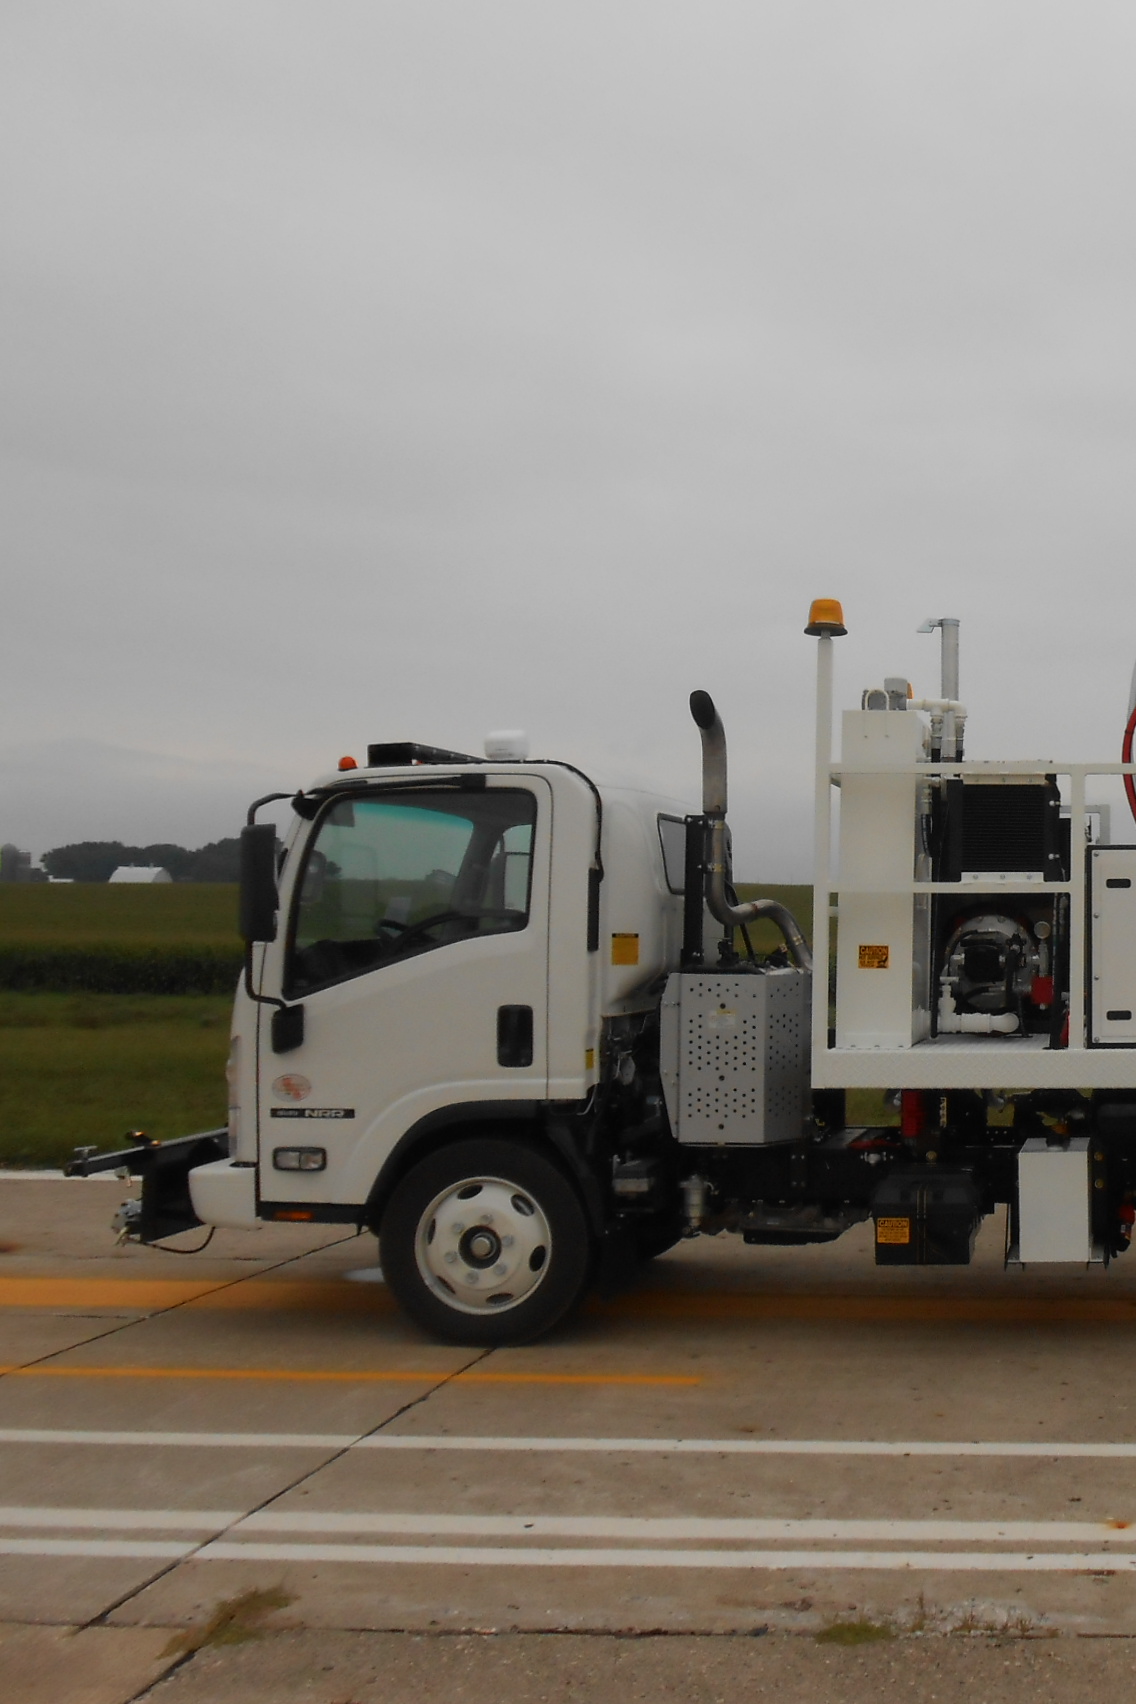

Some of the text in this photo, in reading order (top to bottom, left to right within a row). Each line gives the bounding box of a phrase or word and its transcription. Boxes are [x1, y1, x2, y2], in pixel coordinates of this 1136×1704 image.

[860, 946, 887, 955] CAUTION
[304, 1109, 345, 1118] NRR
[879, 1220, 907, 1228] CAUTION
